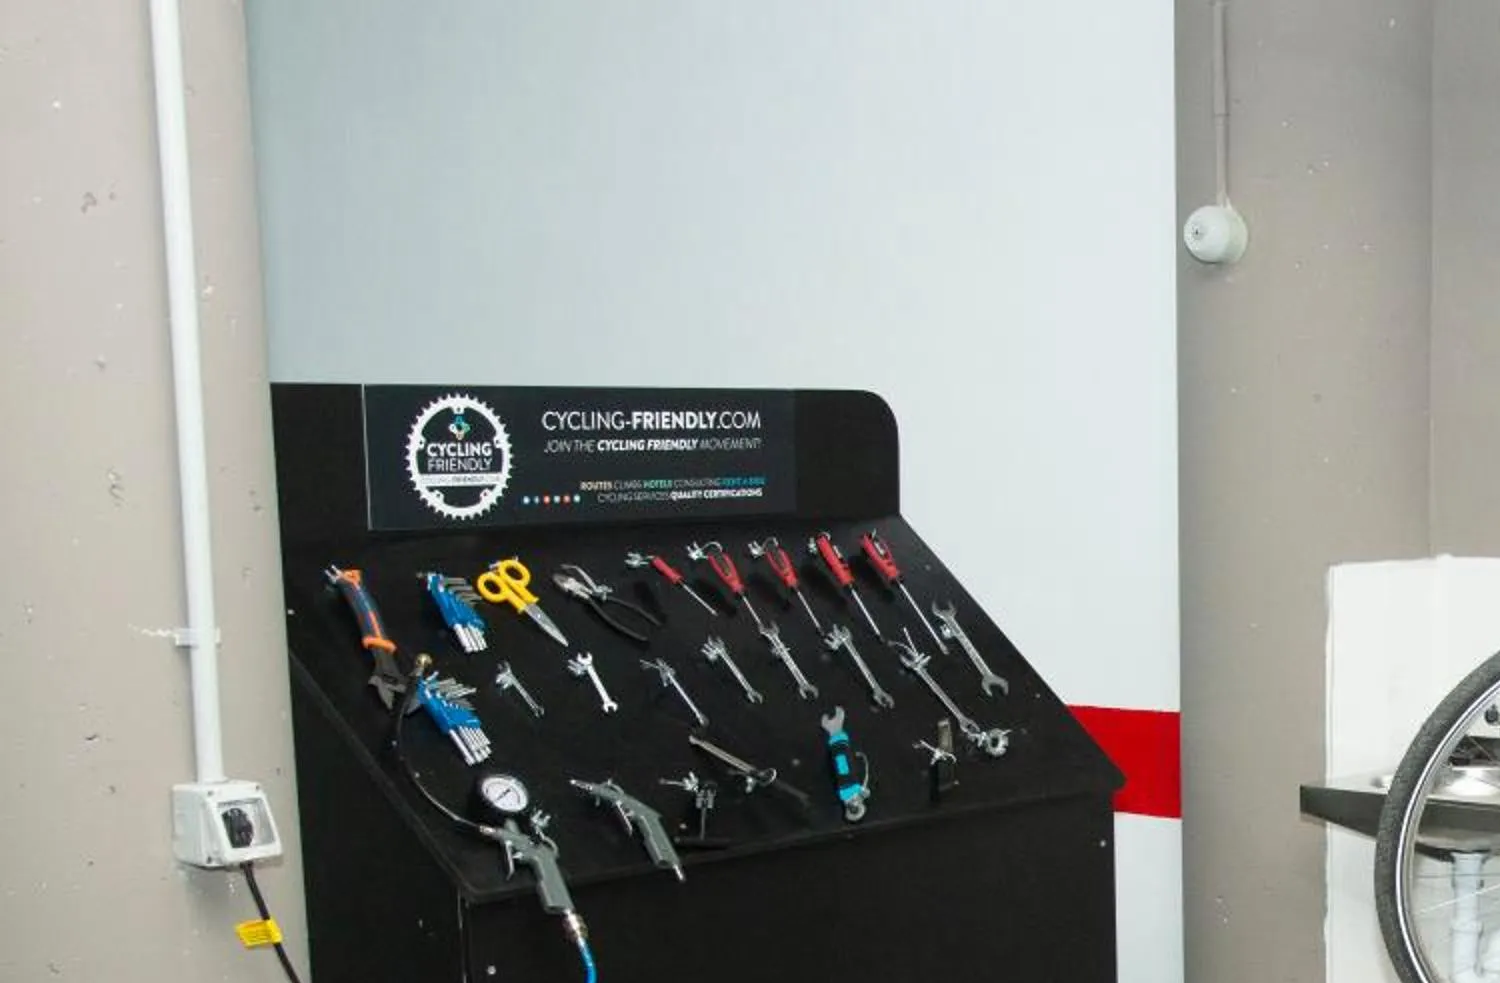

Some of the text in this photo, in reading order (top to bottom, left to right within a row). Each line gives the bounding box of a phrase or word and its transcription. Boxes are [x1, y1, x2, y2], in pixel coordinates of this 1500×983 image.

[541, 410, 762, 431] CYCLING-FRIENDLY.COM
[427, 441, 493, 457] CYCLING
[543, 439, 571, 453] JOIN
[576, 439, 597, 452] THE
[597, 438, 645, 452] CYCLING
[647, 437, 699, 451] FRIENDLY
[427, 457, 493, 472] FRIENDLY
